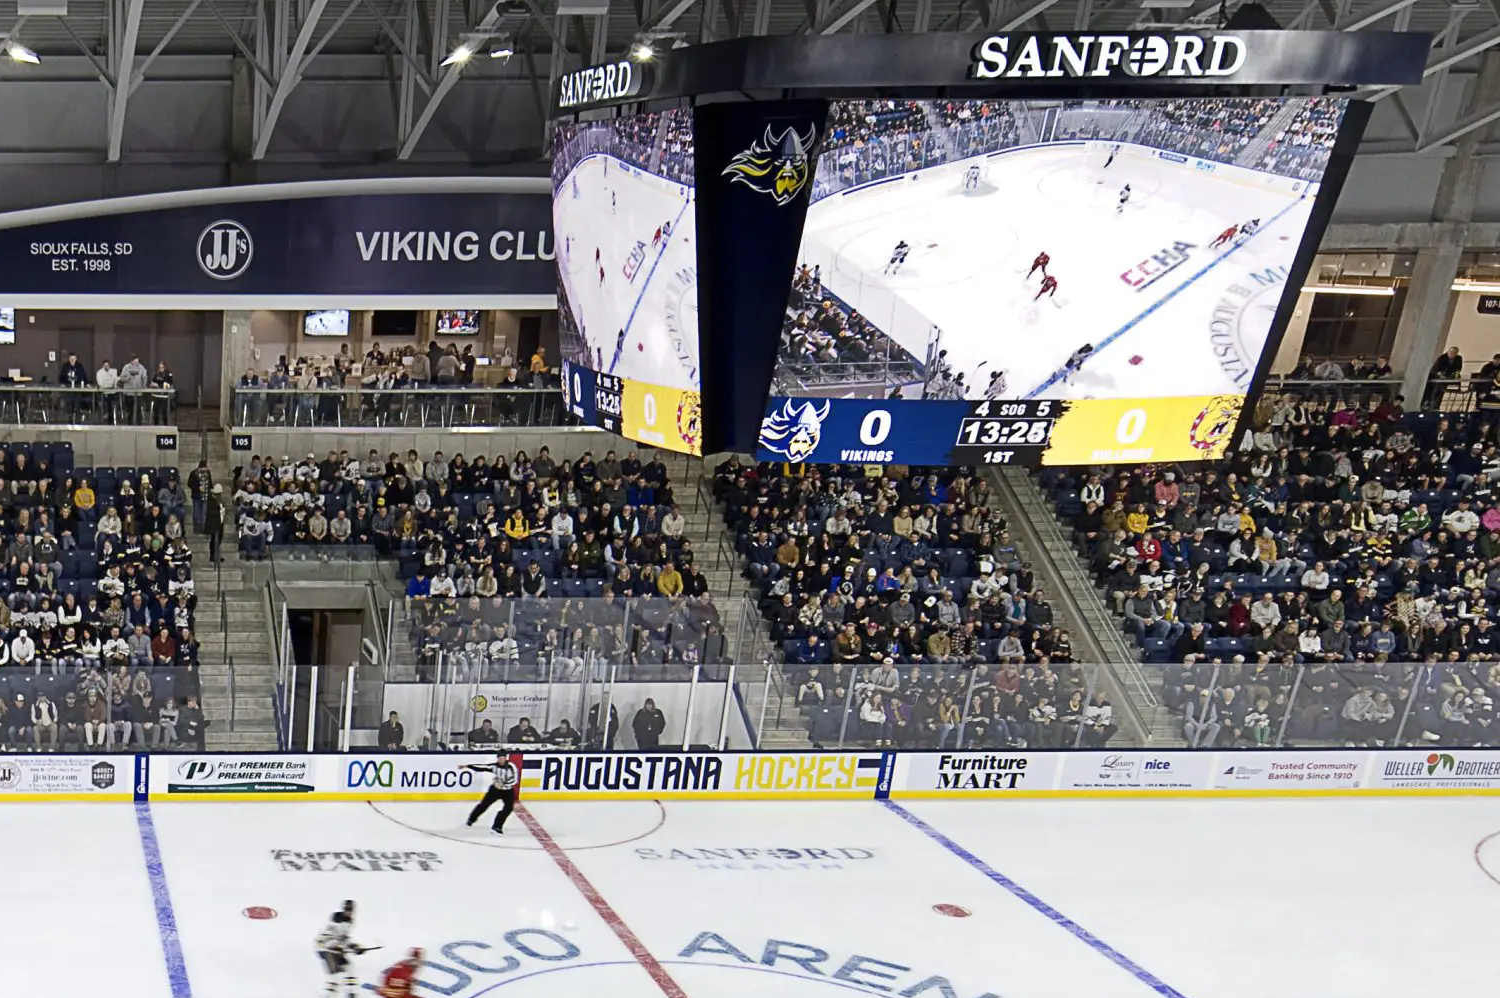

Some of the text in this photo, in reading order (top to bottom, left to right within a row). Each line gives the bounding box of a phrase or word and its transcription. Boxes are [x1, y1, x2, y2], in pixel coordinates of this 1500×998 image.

[976, 34, 1247, 78] SANFORD
[558, 60, 632, 108] SANFORD
[30, 242, 133, 258] SIOUX FALLS, SD
[355, 230, 480, 262] VIKING
[51, 259, 112, 272] EST. 1998
[1119, 240, 1198, 288] CCHA
[975, 401, 1050, 416] 4 SOG 5
[859, 410, 892, 446] 0
[1116, 408, 1147, 445] 0
[160, 438, 174, 446] 104
[235, 438, 249, 446] 105
[840, 449, 894, 463] VIKINGS
[983, 451, 1012, 463] 1ST
[217, 761, 307, 769] First PREMIER Bank
[938, 754, 1029, 771] Furniture
[1144, 758, 1171, 770] nice
[1271, 762, 1358, 772] Trusted Community
[1384, 760, 1424, 777] WELLER
[217, 772, 305, 780] PREMIER Bankcard
[401, 769, 474, 789] MIDCO
[542, 756, 722, 790] AUGUSTANA
[734, 755, 859, 790] HOCKEY
[1268, 772, 1353, 782] Banking Since 1910
[935, 772, 1026, 790] MART
[1435, 781, 1492, 789] PROFESSIONALS
[270, 848, 439, 861] Furniture
[633, 847, 876, 860] SANFORD
[279, 859, 443, 872] MART
